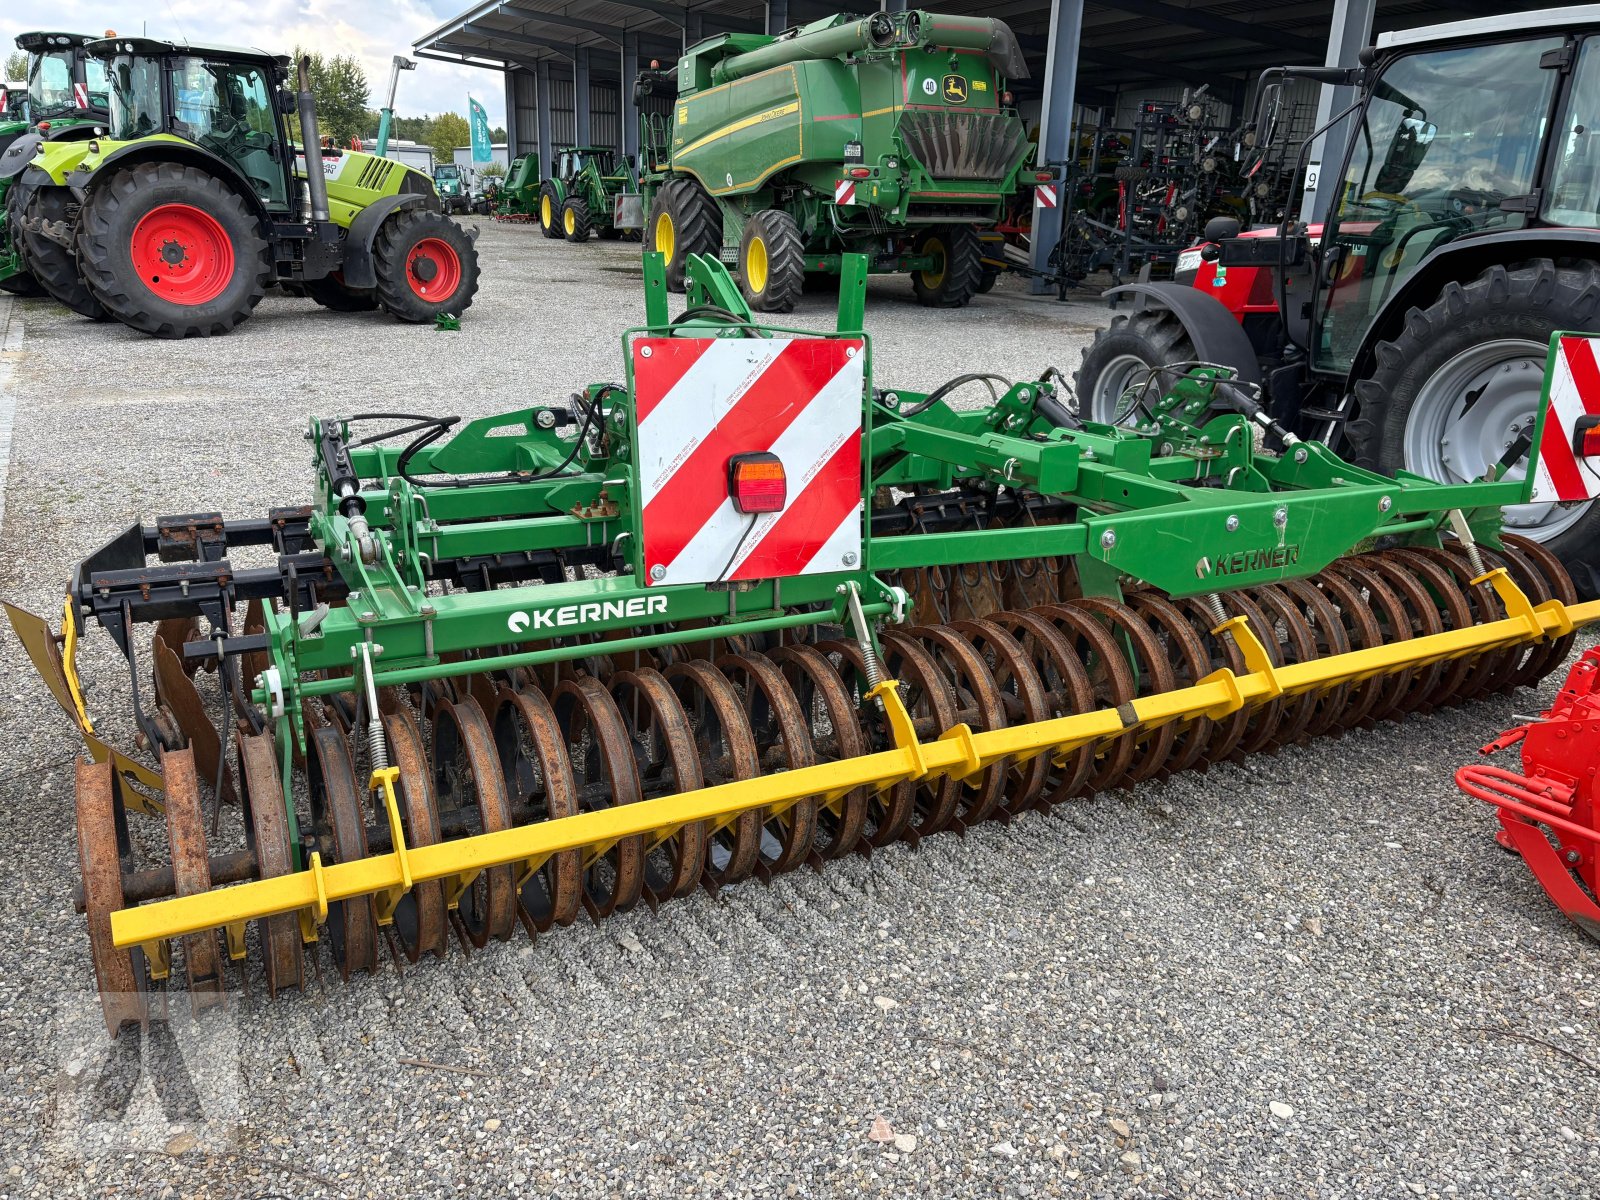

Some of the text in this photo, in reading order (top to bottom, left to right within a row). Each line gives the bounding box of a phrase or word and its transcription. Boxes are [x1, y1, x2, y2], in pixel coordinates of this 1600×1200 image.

[925, 81, 934, 92] 40
[760, 109, 785, 123] JOHN DEERE
[1308, 173, 1316, 187] 9
[1216, 543, 1299, 576] KERNER
[533, 595, 668, 629] KERNER
